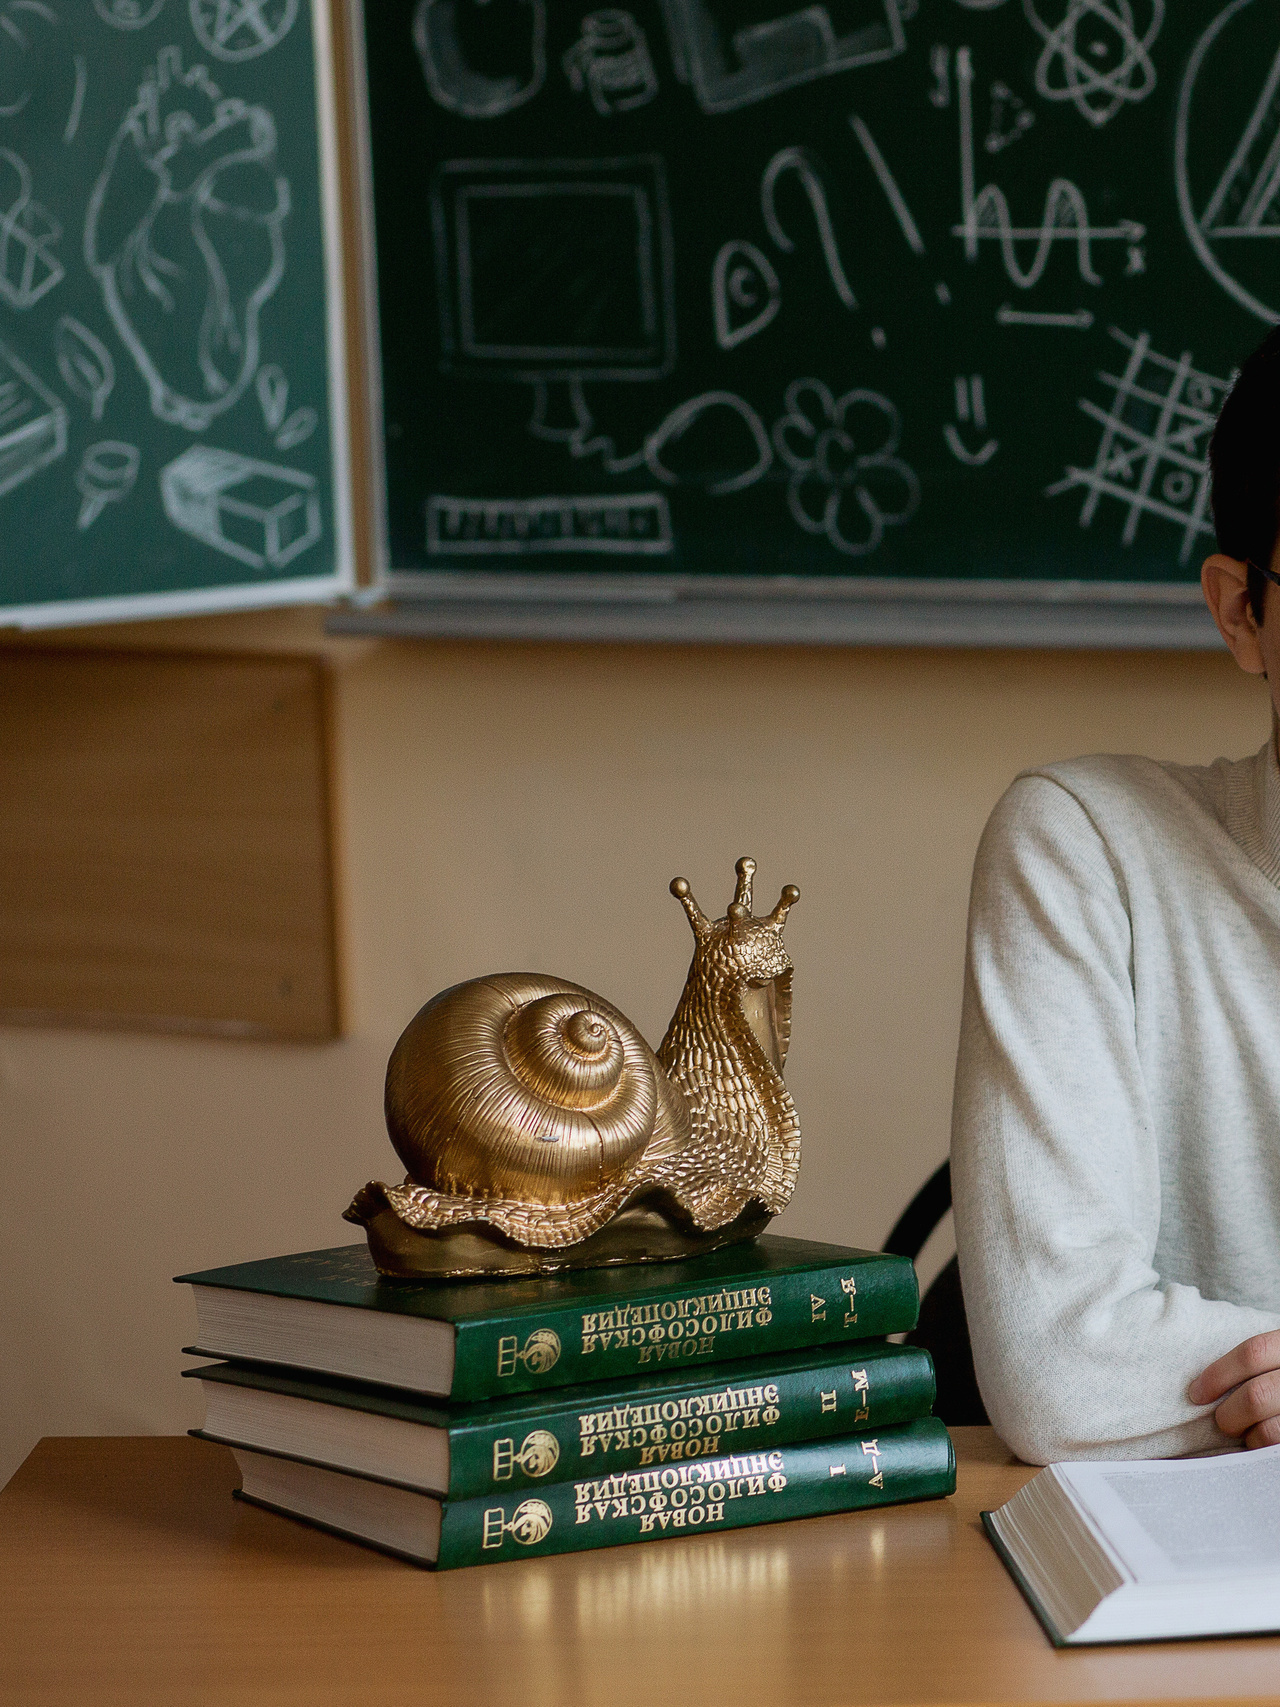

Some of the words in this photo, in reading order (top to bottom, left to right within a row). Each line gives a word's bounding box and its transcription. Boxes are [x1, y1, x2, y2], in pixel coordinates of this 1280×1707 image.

[581, 1286, 772, 1334] ЭНЦИКЛОПЕДИЯ
[581, 1306, 773, 1355] ФИЛОСОФСКАЯ
[810, 1293, 827, 1323] IV
[638, 1335, 716, 1364] НОВАЯ
[578, 1384, 780, 1436] ЭНЦИКЛОПЕДИЯ
[820, 1389, 837, 1414] II
[580, 1405, 781, 1457] ФИЛОСОФСКАЯ
[639, 1435, 721, 1466] НОВАЯ
[573, 1451, 785, 1504] ЭНЦИКЛОПЕДИЯ
[575, 1472, 788, 1525] ФИЛОСОФСКАЯ
[640, 1502, 725, 1533] НОВАЯ
